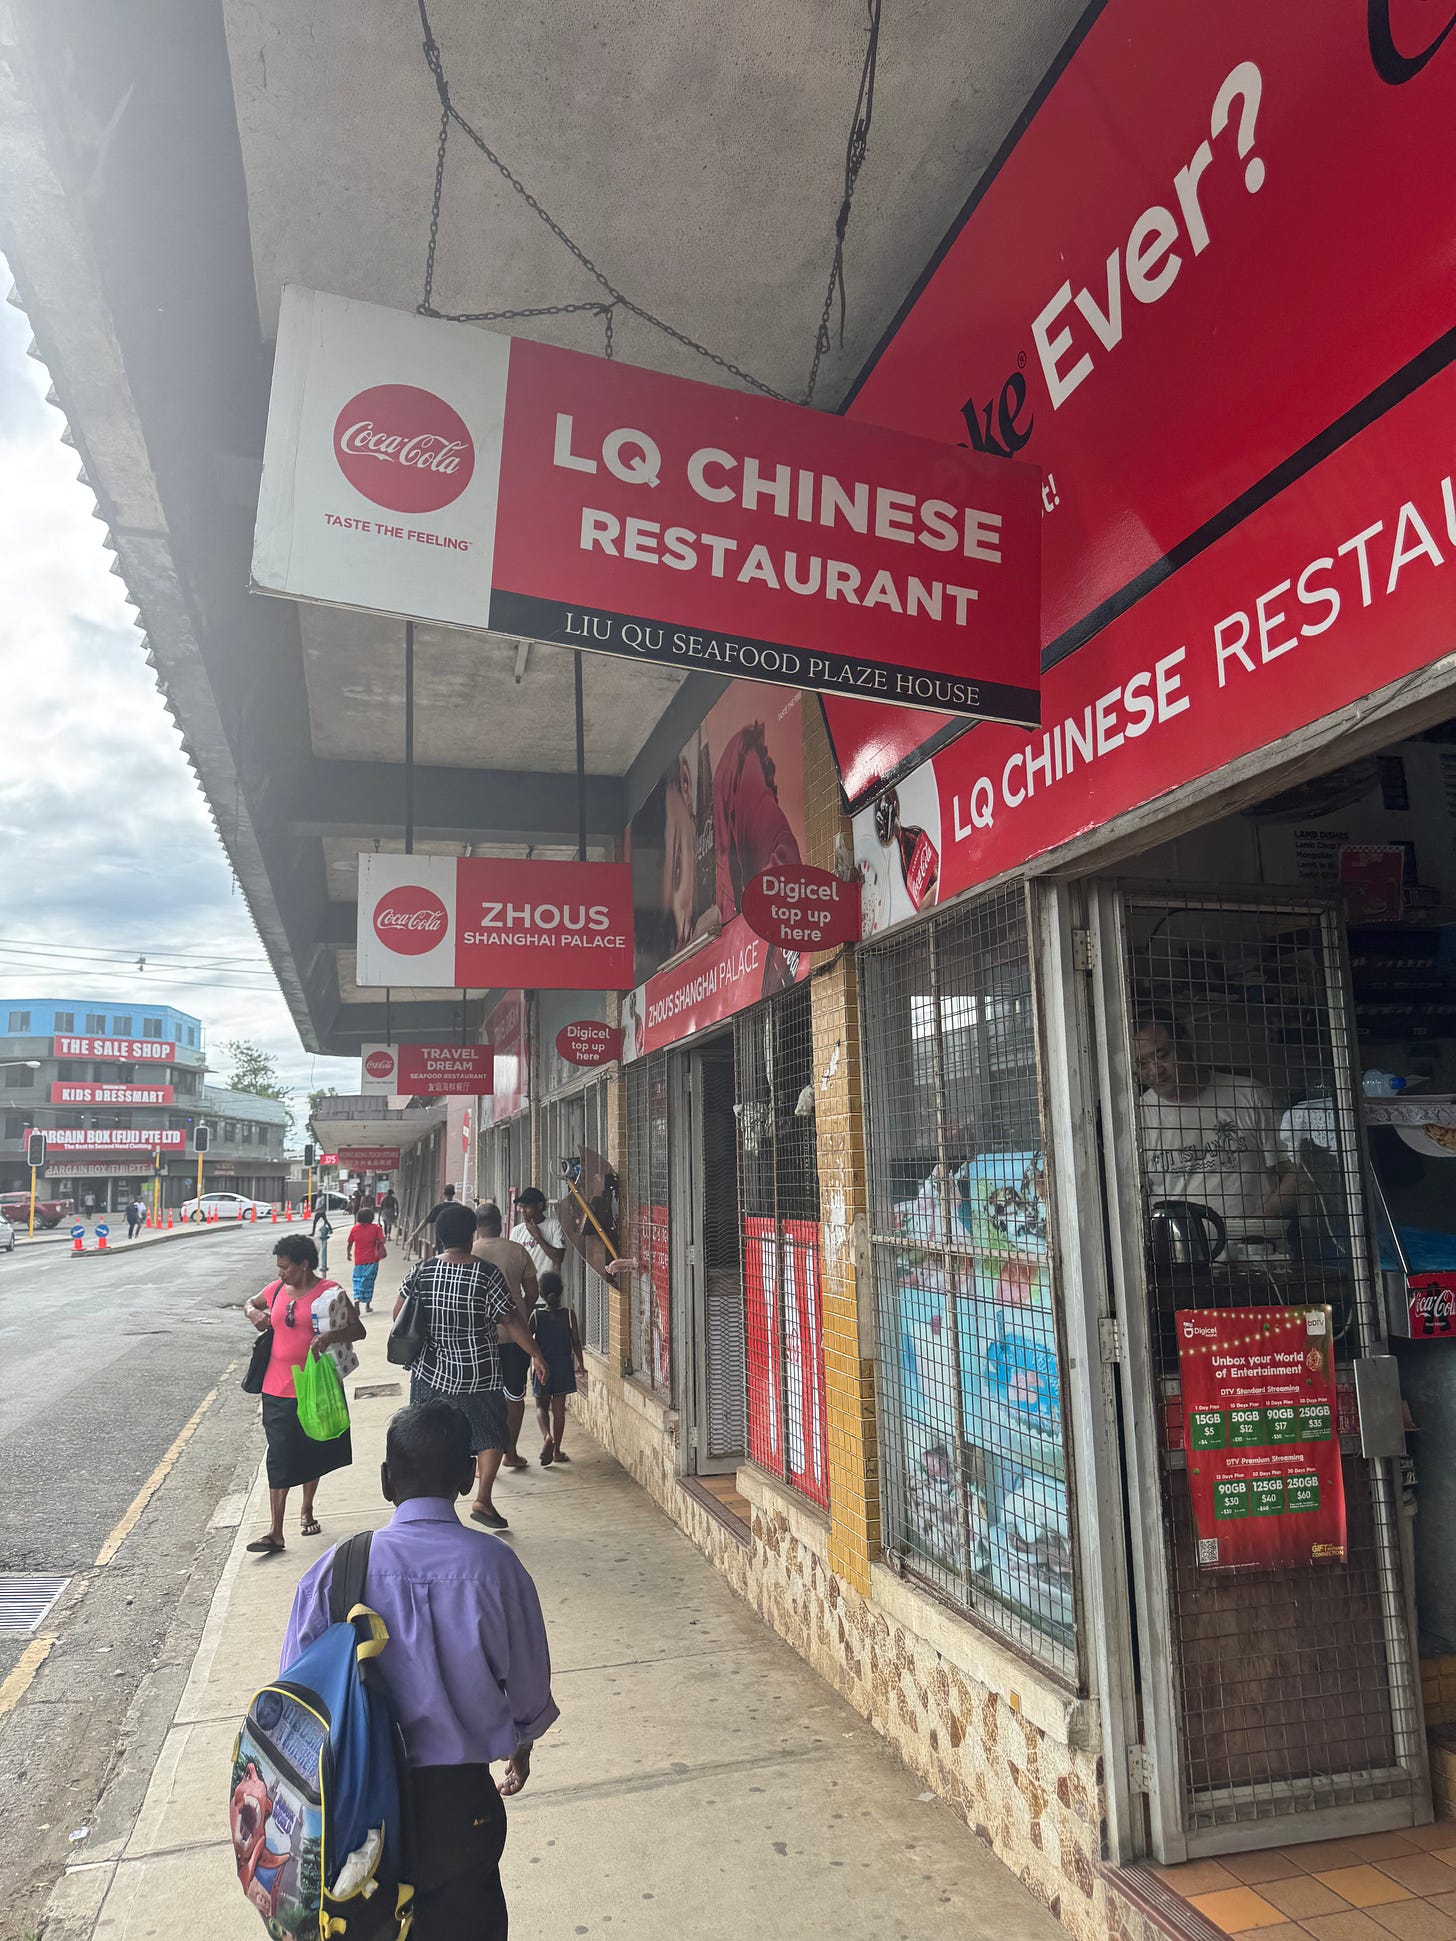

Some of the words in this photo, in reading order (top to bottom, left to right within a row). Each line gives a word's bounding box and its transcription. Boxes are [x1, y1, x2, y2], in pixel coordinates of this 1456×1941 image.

[1031, 61, 1266, 411] Ever?
[340, 421, 468, 474] Coca-Cola
[553, 411, 663, 489] LQ
[686, 448, 1002, 564] CHINESE
[324, 513, 371, 533] TASTE
[375, 523, 404, 539] THE
[579, 508, 979, 627] RESTAURANT
[564, 612, 612, 640] LIU
[621, 623, 664, 652] QU
[672, 633, 800, 675] SEAFOOD
[809, 657, 888, 690] PLAZE
[896, 674, 981, 707] HOUSE
[952, 776, 994, 842] LQ
[1002, 646, 1190, 809] CHINESE
[1295, 831, 1318, 839] LAMB
[1320, 832, 1349, 840] DISHES
[762, 875, 840, 903] Digicel
[377, 908, 446, 931] Coca-Cola
[481, 902, 610, 930] ZHOUS
[771, 903, 802, 922] top
[807, 908, 831, 926] up
[780, 923, 822, 942] here
[463, 931, 556, 947] SHANGHAI
[561, 934, 626, 948] PALACE
[648, 993, 674, 1028] ZHOU'S
[674, 971, 718, 1010] SHANGHAI
[719, 940, 759, 988] PALACE
[567, 1025, 610, 1040] Digicel
[61, 1038, 89, 1054] THE
[93, 1040, 129, 1056] SALE
[132, 1042, 170, 1058] SHOP
[571, 1040, 589, 1051] top
[592, 1041, 605, 1052] up
[421, 1048, 479, 1059] TRAVEL
[576, 1051, 600, 1061] here
[427, 1061, 473, 1070] DREAM
[62, 1088, 92, 1101] KIDS
[95, 1089, 165, 1103] DRESSMART
[40, 1130, 86, 1143] ARGAIN
[87, 1130, 111, 1143] BOX
[141, 1130, 161, 1143] PTE
[162, 1130, 181, 1143] LTD
[47, 1165, 88, 1175] BARGAIN
[88, 1165, 107, 1174] BOX
[129, 1164, 148, 1173] PTE
[1194, 1327, 1217, 1336] Digicel
[1212, 1355, 1245, 1366] Unbox
[1248, 1355, 1271, 1366] your
[1274, 1352, 1304, 1362] World
[1215, 1368, 1227, 1378] of
[1231, 1364, 1302, 1378] Entertainment
[1221, 1388, 1235, 1396] DTV
[1236, 1386, 1266, 1394] Standard
[1267, 1384, 1300, 1393] Streaming
[1231, 1411, 1260, 1422] 50GB
[1266, 1408, 1294, 1419] 90GB
[1299, 1405, 1330, 1417] 250GB
[1195, 1413, 1221, 1424] 15GB
[1308, 1419, 1322, 1428] $35
[1204, 1427, 1215, 1436] $5
[1239, 1424, 1253, 1433] $12
[1274, 1421, 1288, 1431] $17
[1226, 1458, 1239, 1466] DTV
[1241, 1456, 1271, 1464] Premium
[1271, 1454, 1304, 1463] Streaming
[1218, 1482, 1247, 1495] 90GB
[1252, 1480, 1283, 1492] 125GB
[1286, 1476, 1319, 1489] 250GB
[1261, 1493, 1276, 1503] $40
[1297, 1490, 1311, 1500] $60
[1224, 1497, 1239, 1507] $30
